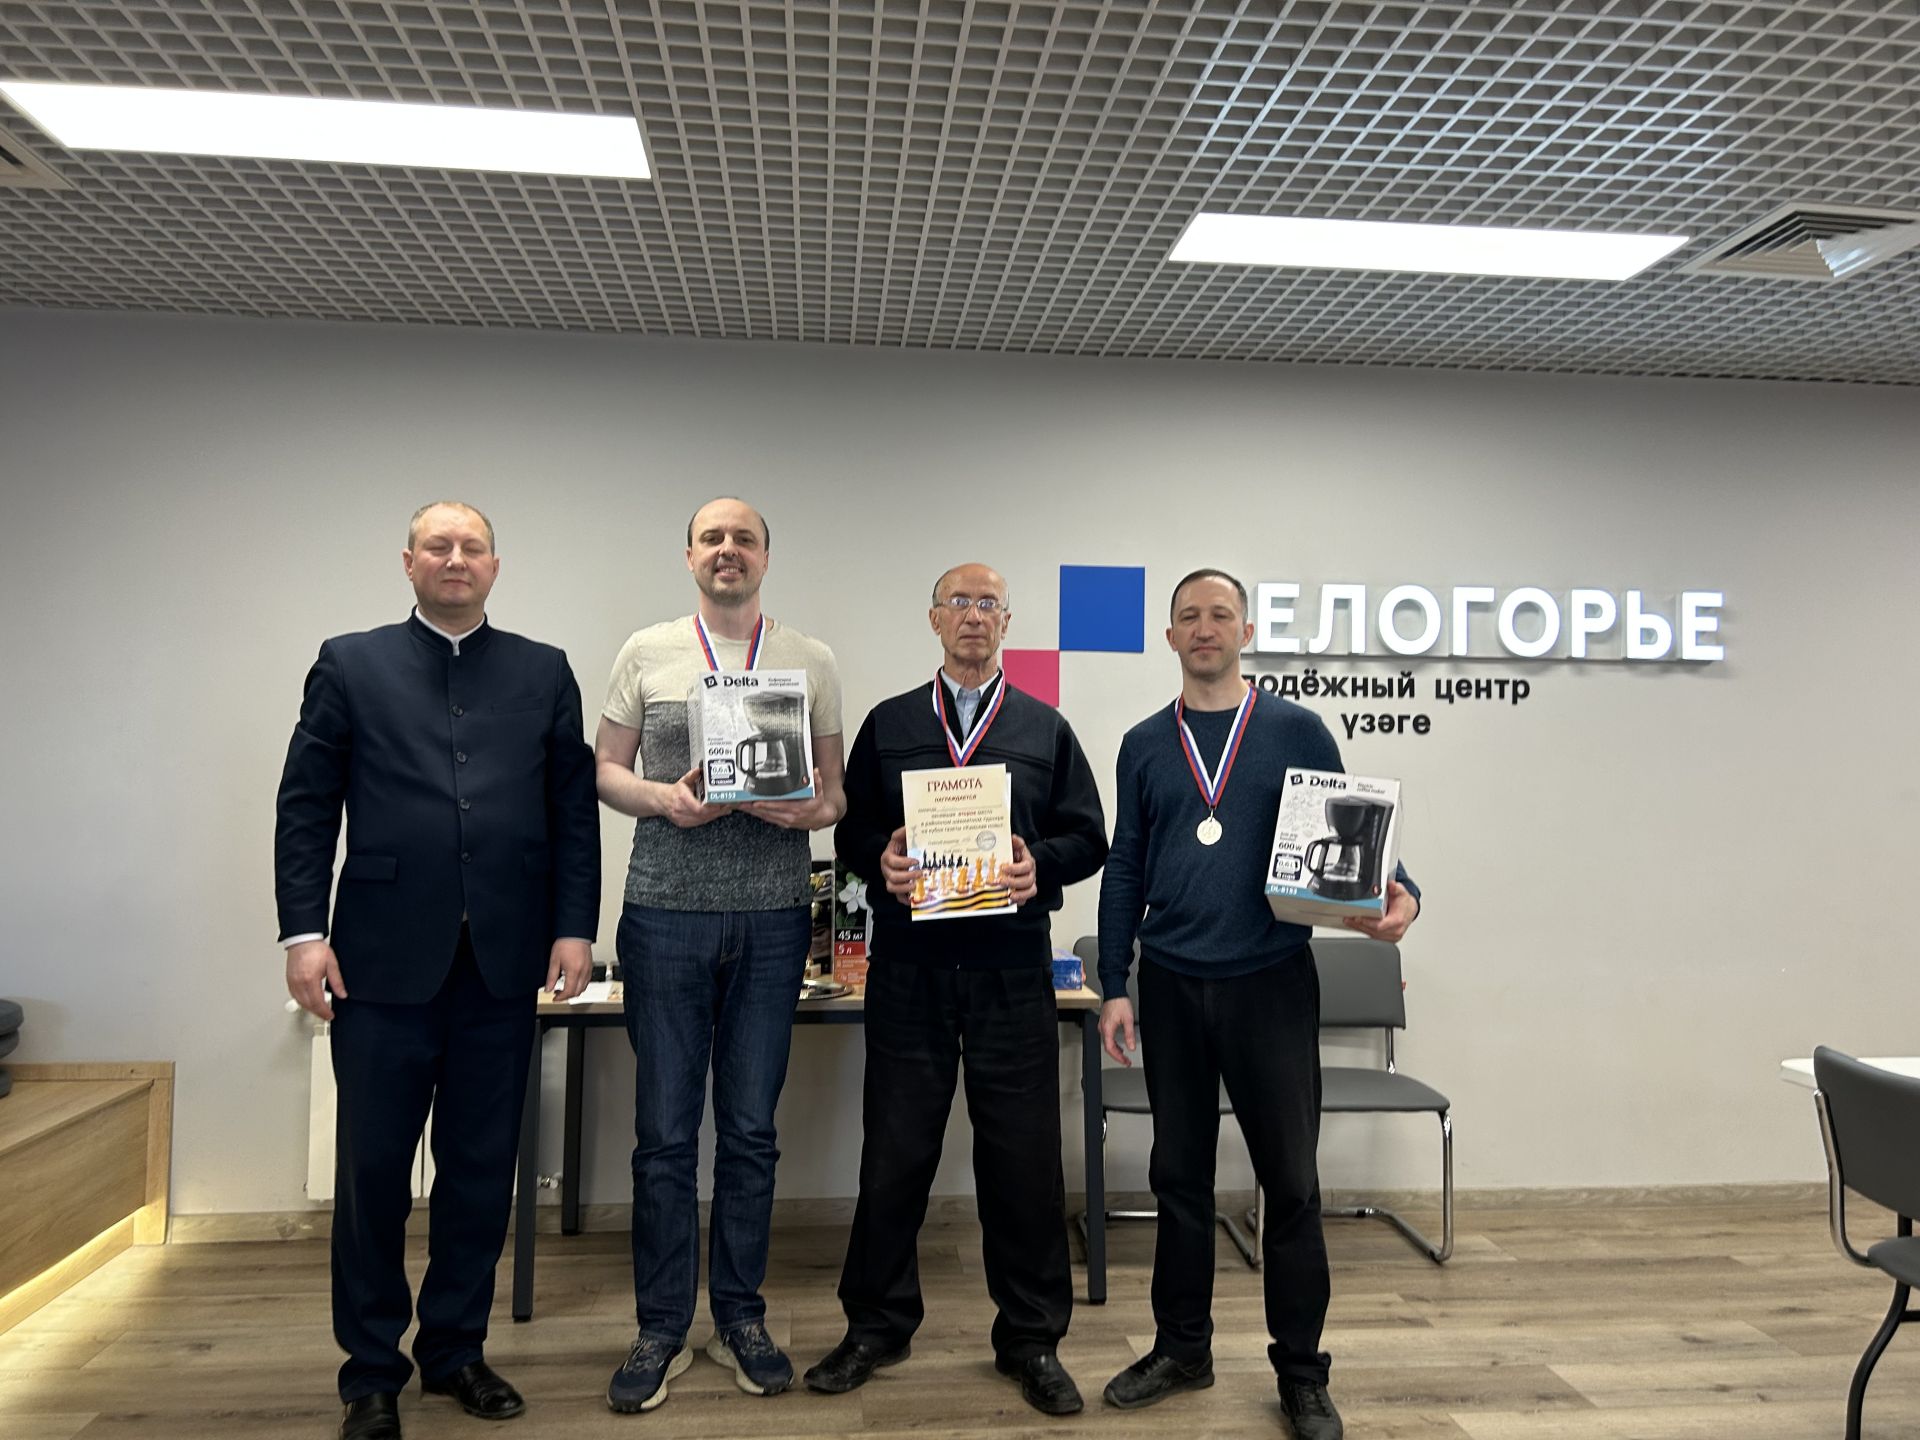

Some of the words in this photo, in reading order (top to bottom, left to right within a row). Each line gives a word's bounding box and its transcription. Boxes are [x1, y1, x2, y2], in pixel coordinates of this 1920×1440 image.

[1255, 582, 1725, 662] ЕЛОГОРЬЕ
[723, 676, 759, 687] Delta
[1241, 668, 1416, 700] одёжный
[1435, 678, 1531, 705] центр
[708, 747, 724, 755] 600
[927, 778, 983, 792] ГРАМОТА
[1309, 775, 1347, 790] Delta
[1278, 842, 1295, 850] 600
[838, 930, 851, 941] 45
[838, 944, 845, 954] 5
